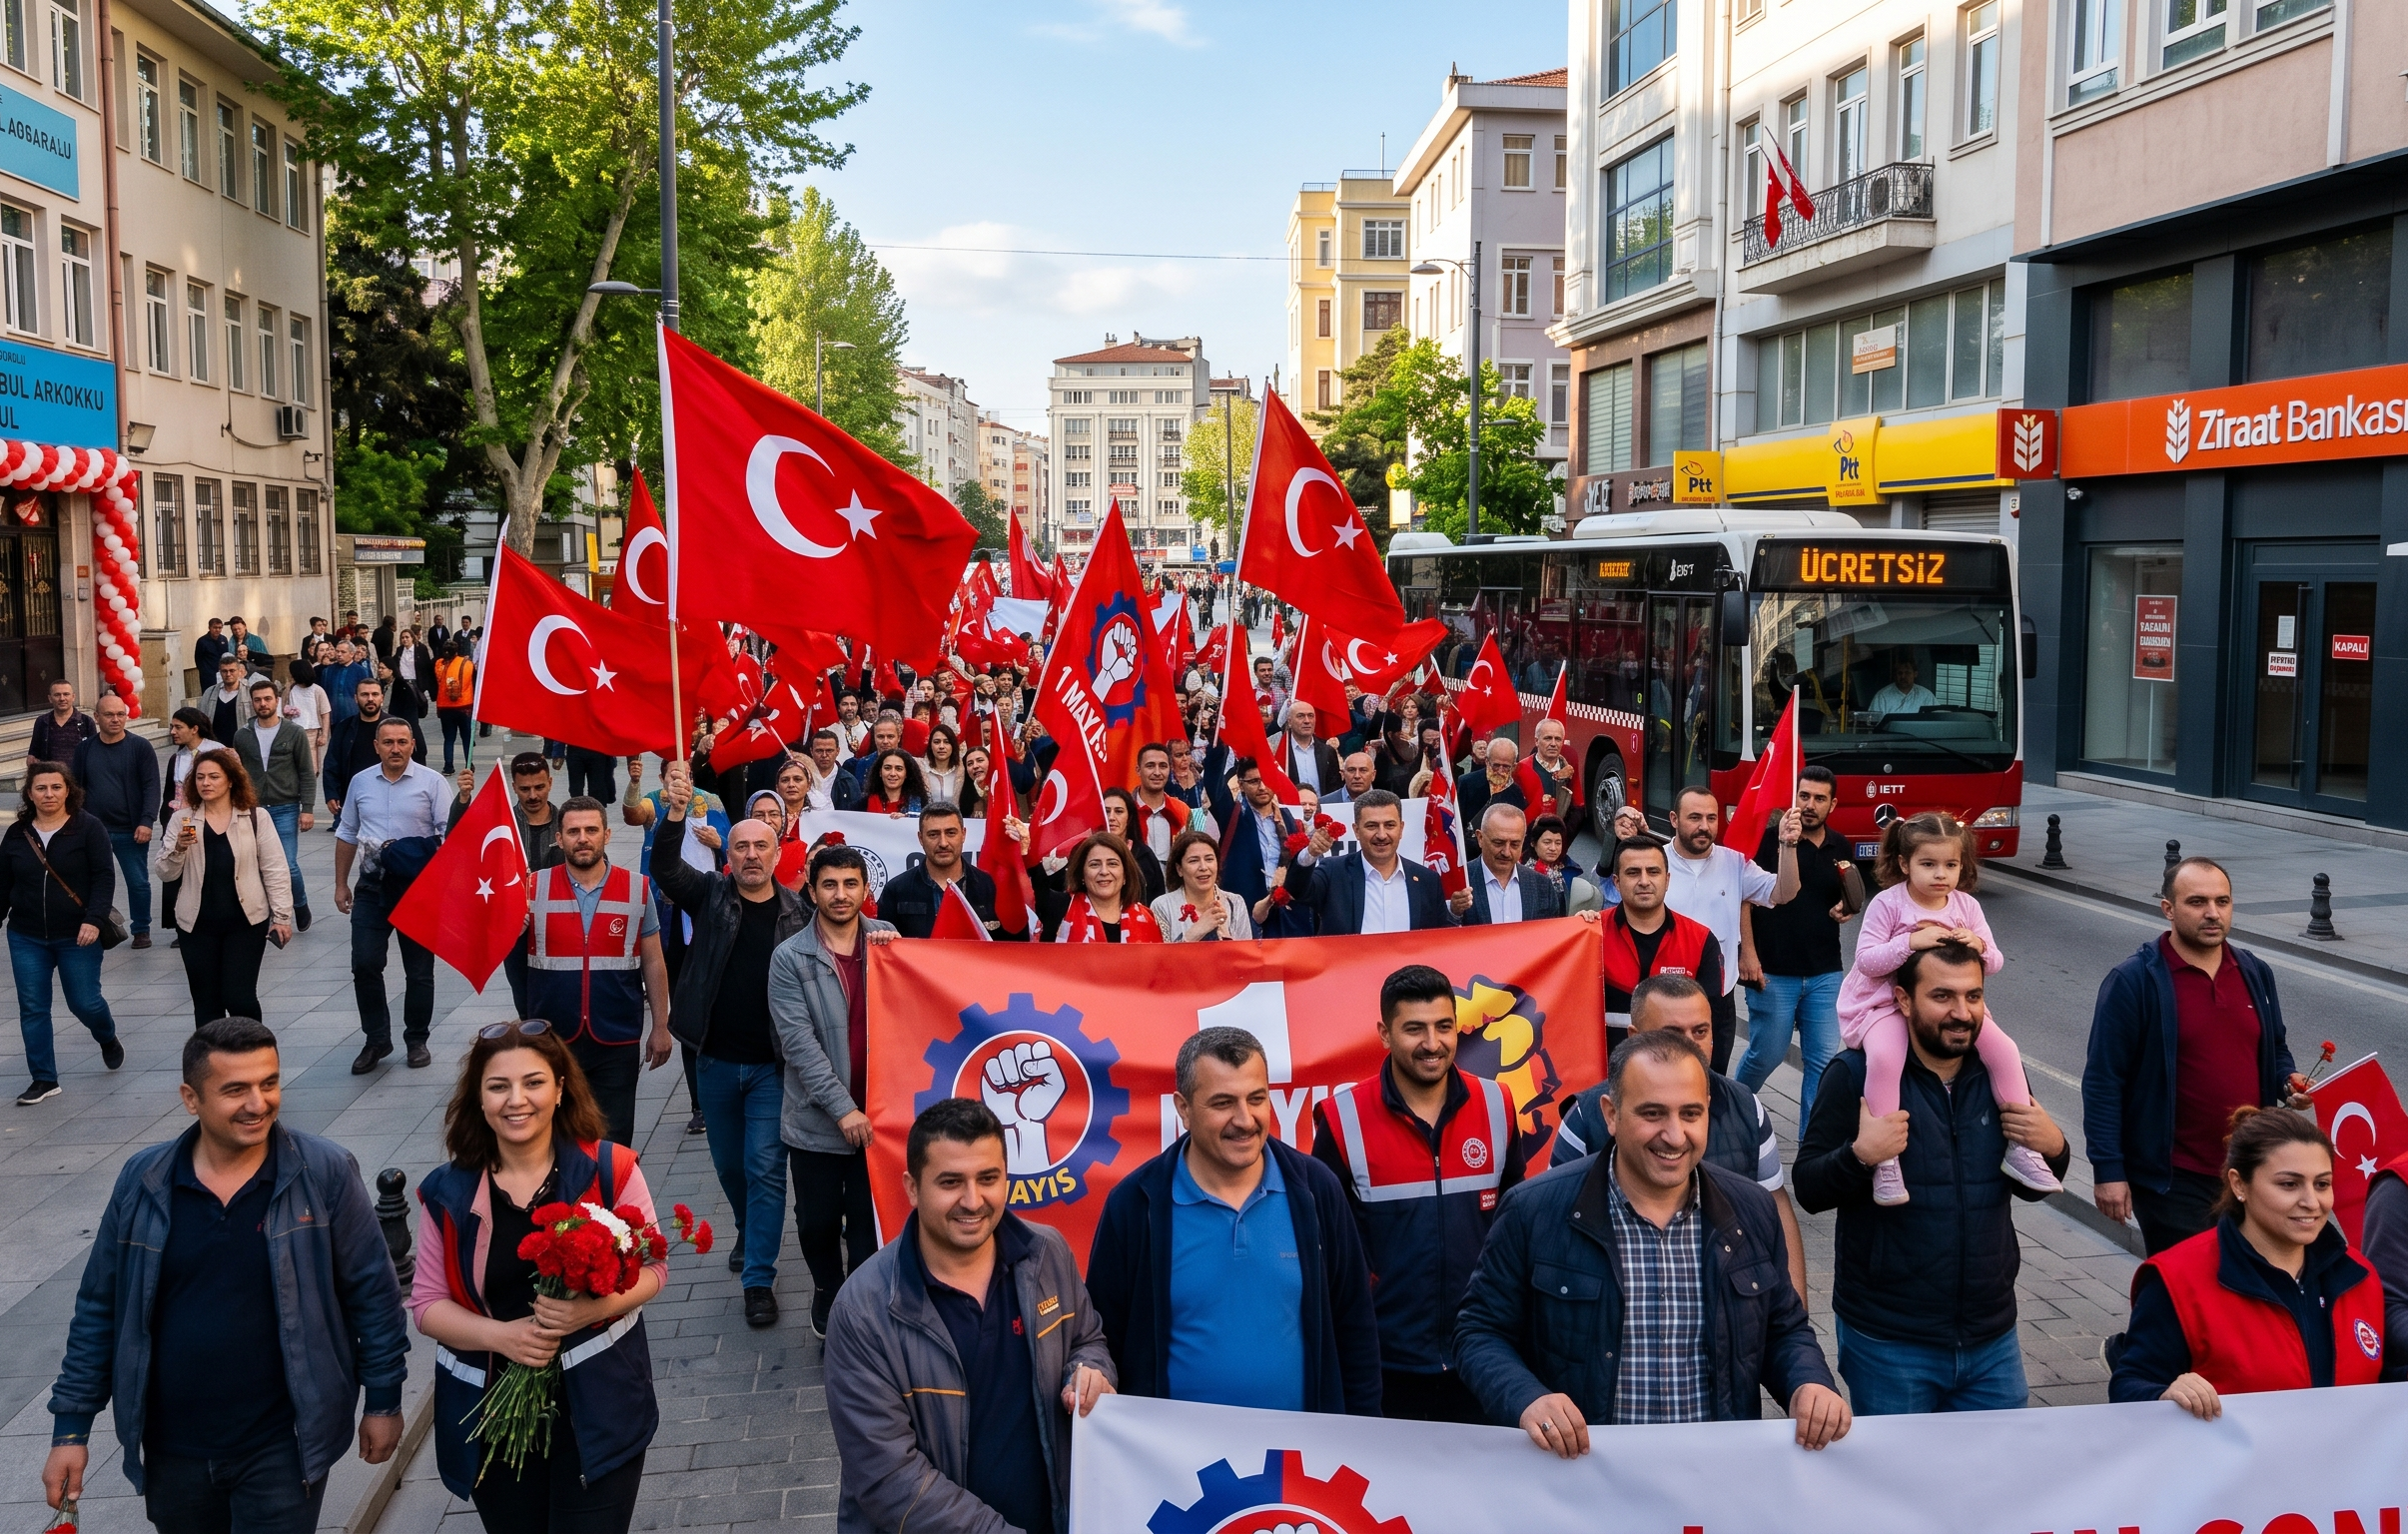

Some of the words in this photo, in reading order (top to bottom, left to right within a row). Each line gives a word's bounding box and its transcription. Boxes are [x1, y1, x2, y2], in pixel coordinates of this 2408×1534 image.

[34, 379, 104, 411] ARKOKKU
[2197, 404, 2282, 450] Ziraat
[1841, 455, 1859, 481] Ptt
[1688, 476, 1713, 493] Ptt
[2334, 641, 2367, 653] KAPALI
[1056, 666, 1072, 692] 1
[1880, 785, 1906, 794] IETT
[1198, 981, 1291, 1084] 1
[1004, 1167, 1077, 1204] AYIS
